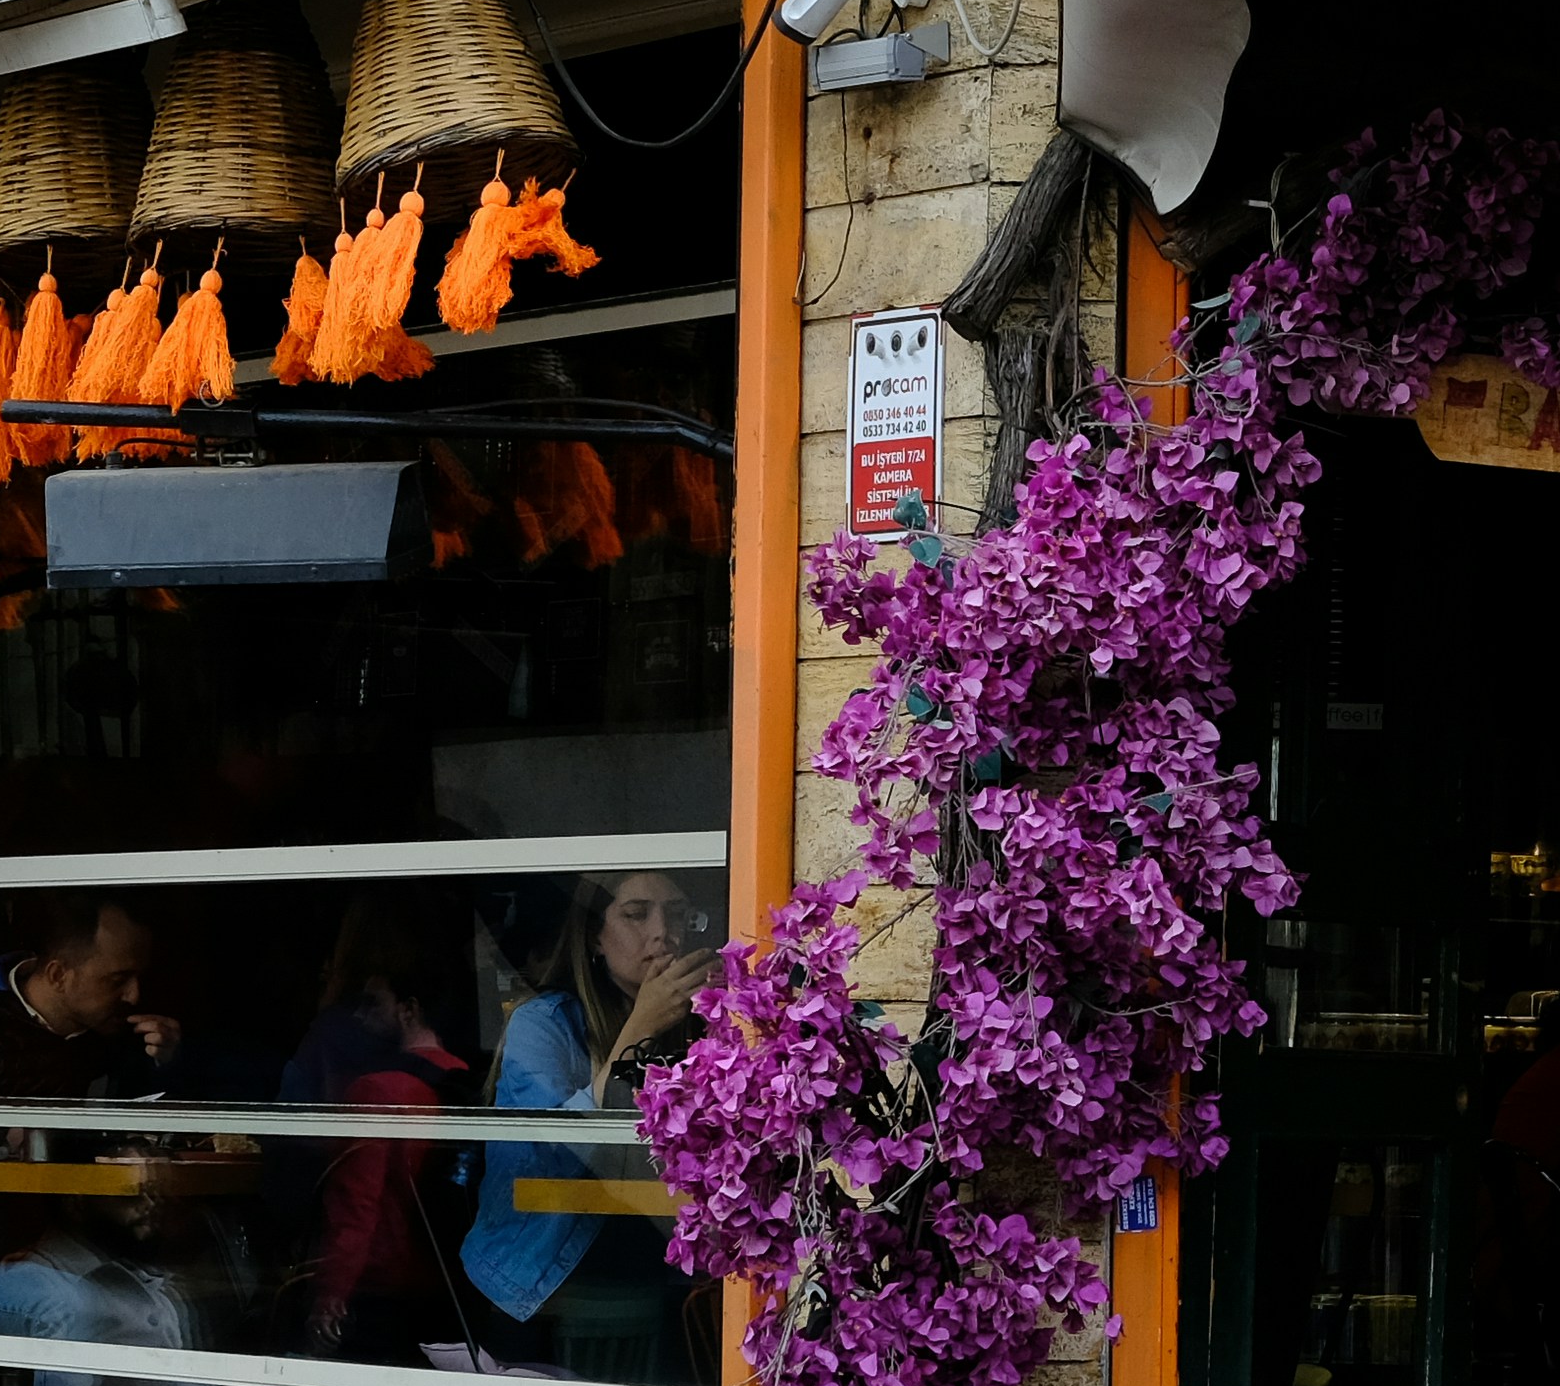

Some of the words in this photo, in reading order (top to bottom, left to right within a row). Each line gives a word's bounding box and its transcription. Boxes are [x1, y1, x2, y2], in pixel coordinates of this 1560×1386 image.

[862, 408, 884, 423] 0850
[885, 406, 902, 420] 346
[903, 405, 915, 419] 40
[915, 404, 927, 417] 44
[862, 423, 883, 438] 0533
[885, 421, 902, 436] 734
[902, 420, 915, 434] 42
[915, 418, 927, 433] 40
[861, 454, 876, 468] BU
[876, 447, 906, 470] İŞYERİ
[907, 447, 927, 464] 7/24
[873, 468, 914, 485] KAMERA
